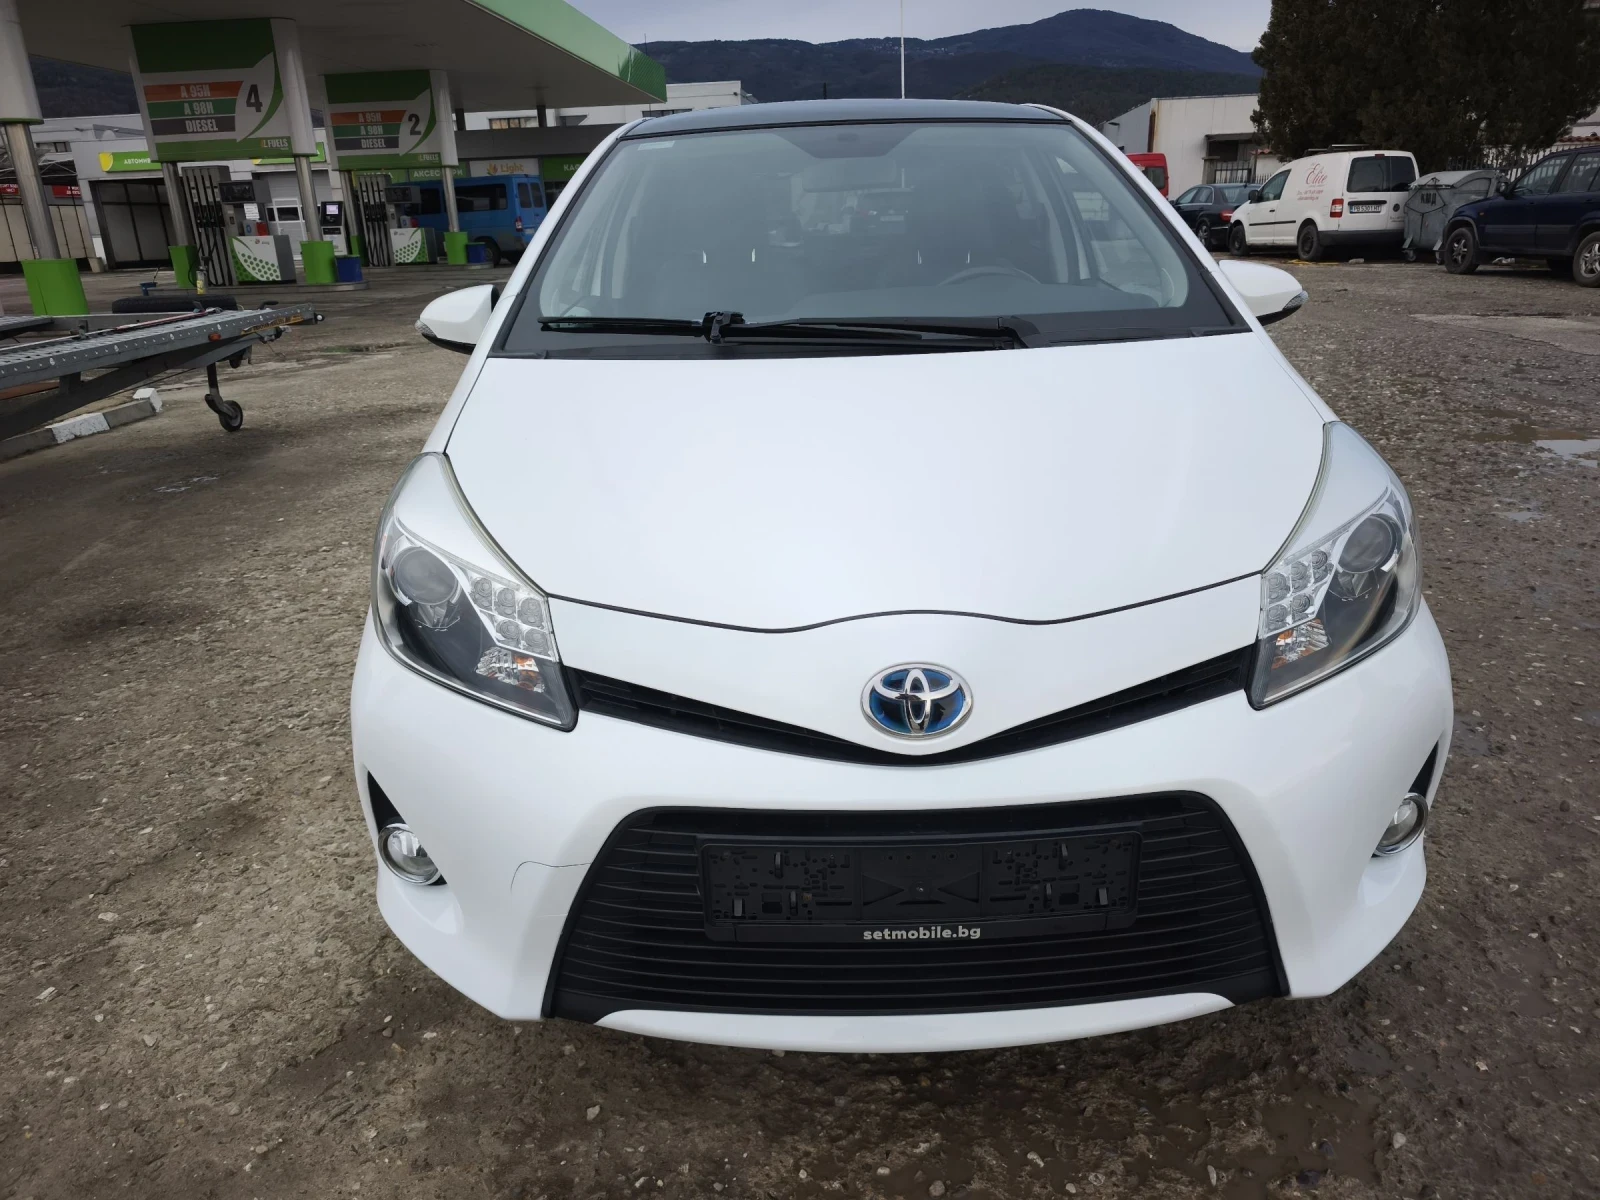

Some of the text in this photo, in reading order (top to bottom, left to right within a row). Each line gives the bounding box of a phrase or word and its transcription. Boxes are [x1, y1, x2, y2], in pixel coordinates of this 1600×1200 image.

[247, 84, 263, 112] 4
[186, 118, 218, 132] DIESEL
[408, 113, 421, 136] 2
[268, 138, 288, 148] FUELS
[361, 138, 386, 149] DIESEL
[414, 168, 463, 178] АКСЕСРИ
[501, 163, 524, 174] Light
[1306, 163, 1328, 185] Elite
[863, 926, 982, 940] setmobile.bg
